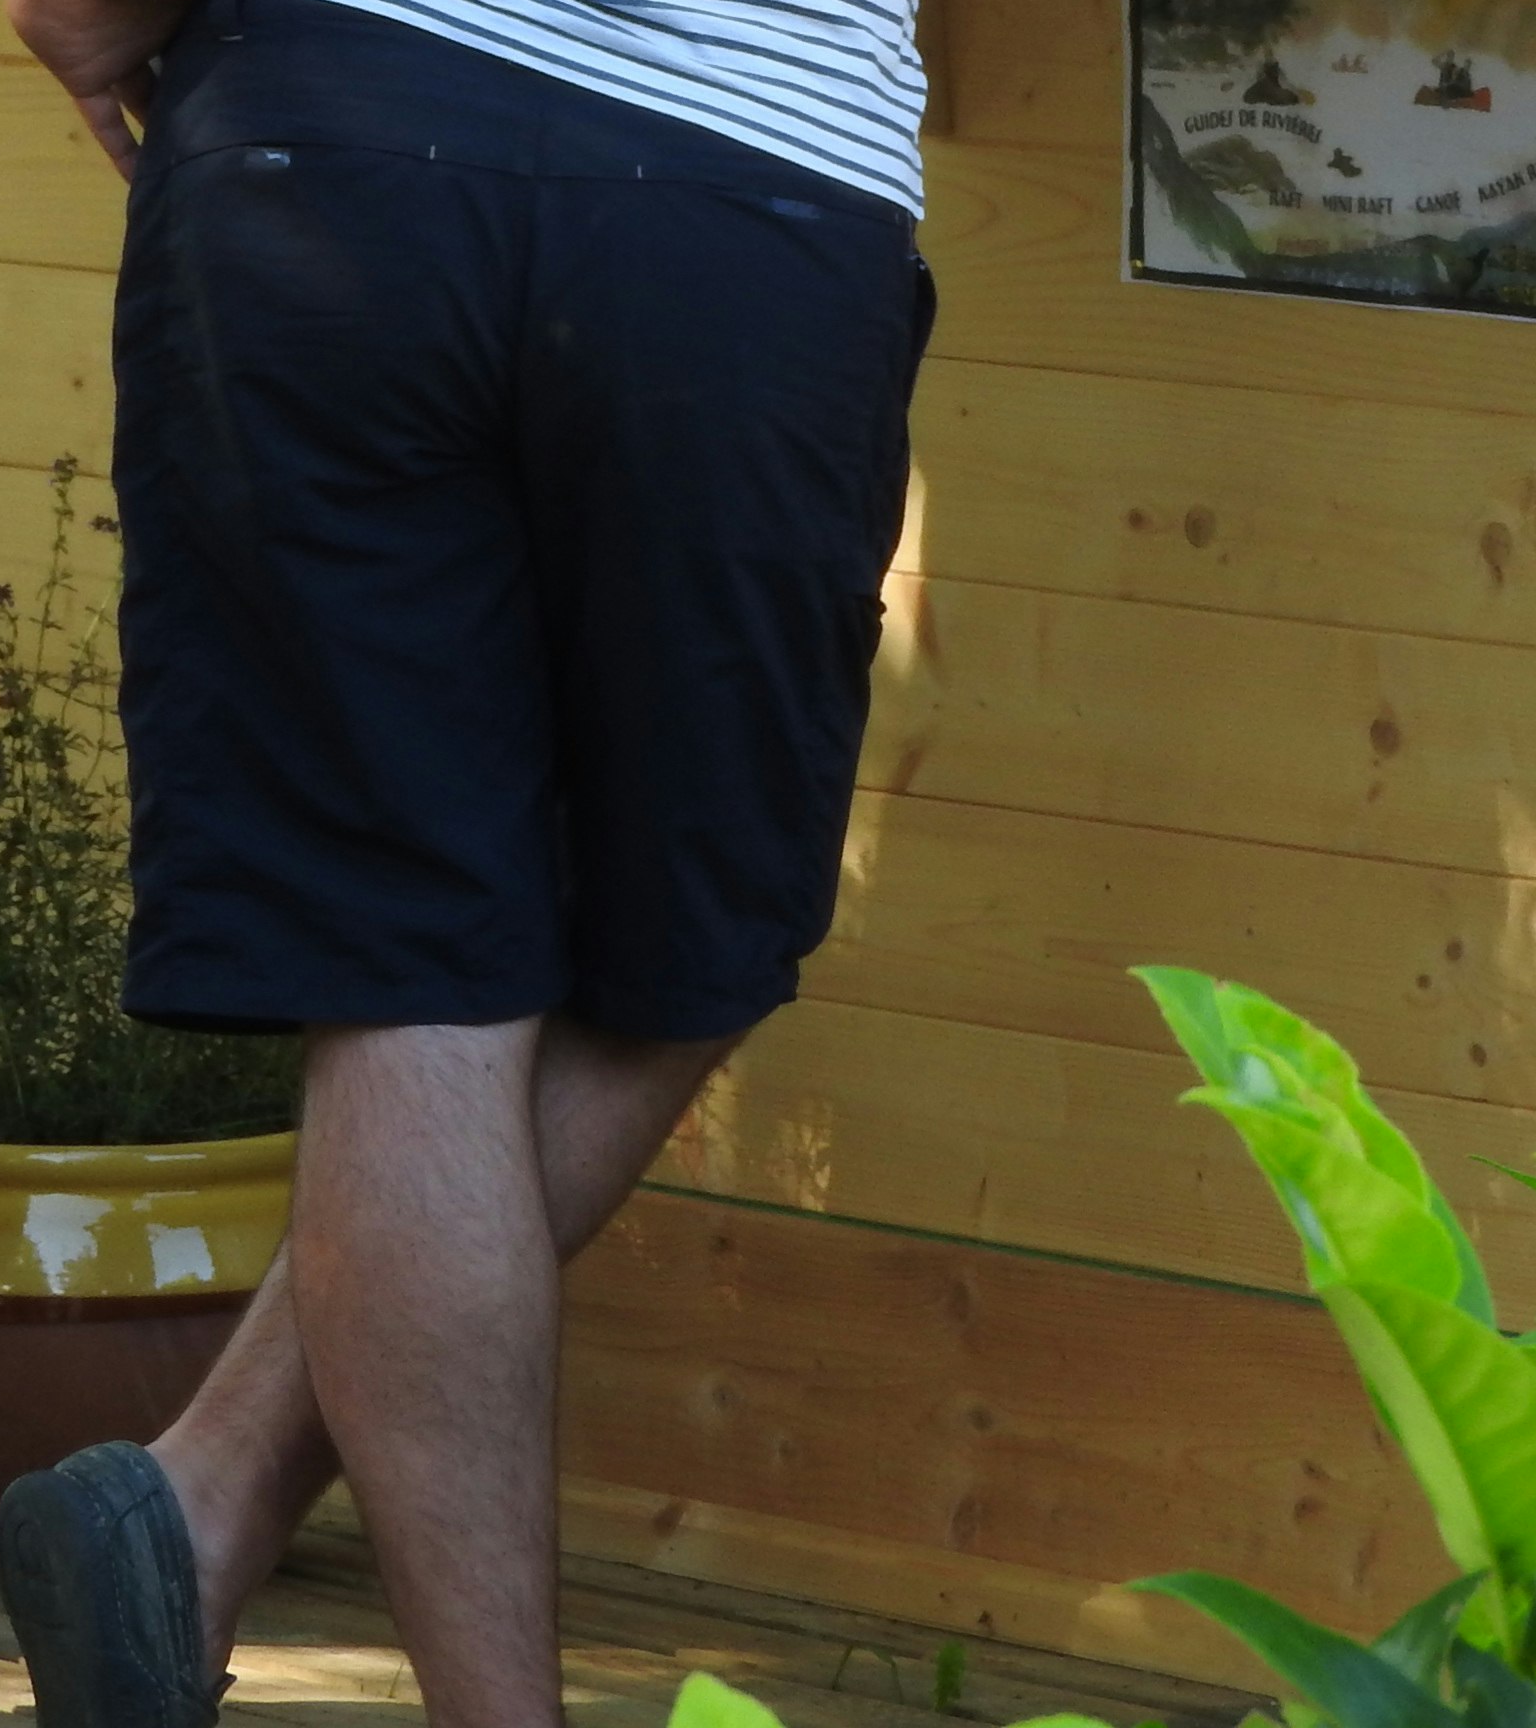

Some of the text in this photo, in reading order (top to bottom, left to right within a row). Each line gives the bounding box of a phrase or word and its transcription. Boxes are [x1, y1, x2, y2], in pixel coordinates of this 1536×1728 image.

[1184, 109, 1233, 133] GUIDES
[1239, 109, 1257, 127] DE
[1269, 191, 1303, 209] RAFT
[1357, 196, 1393, 214] RAFT
